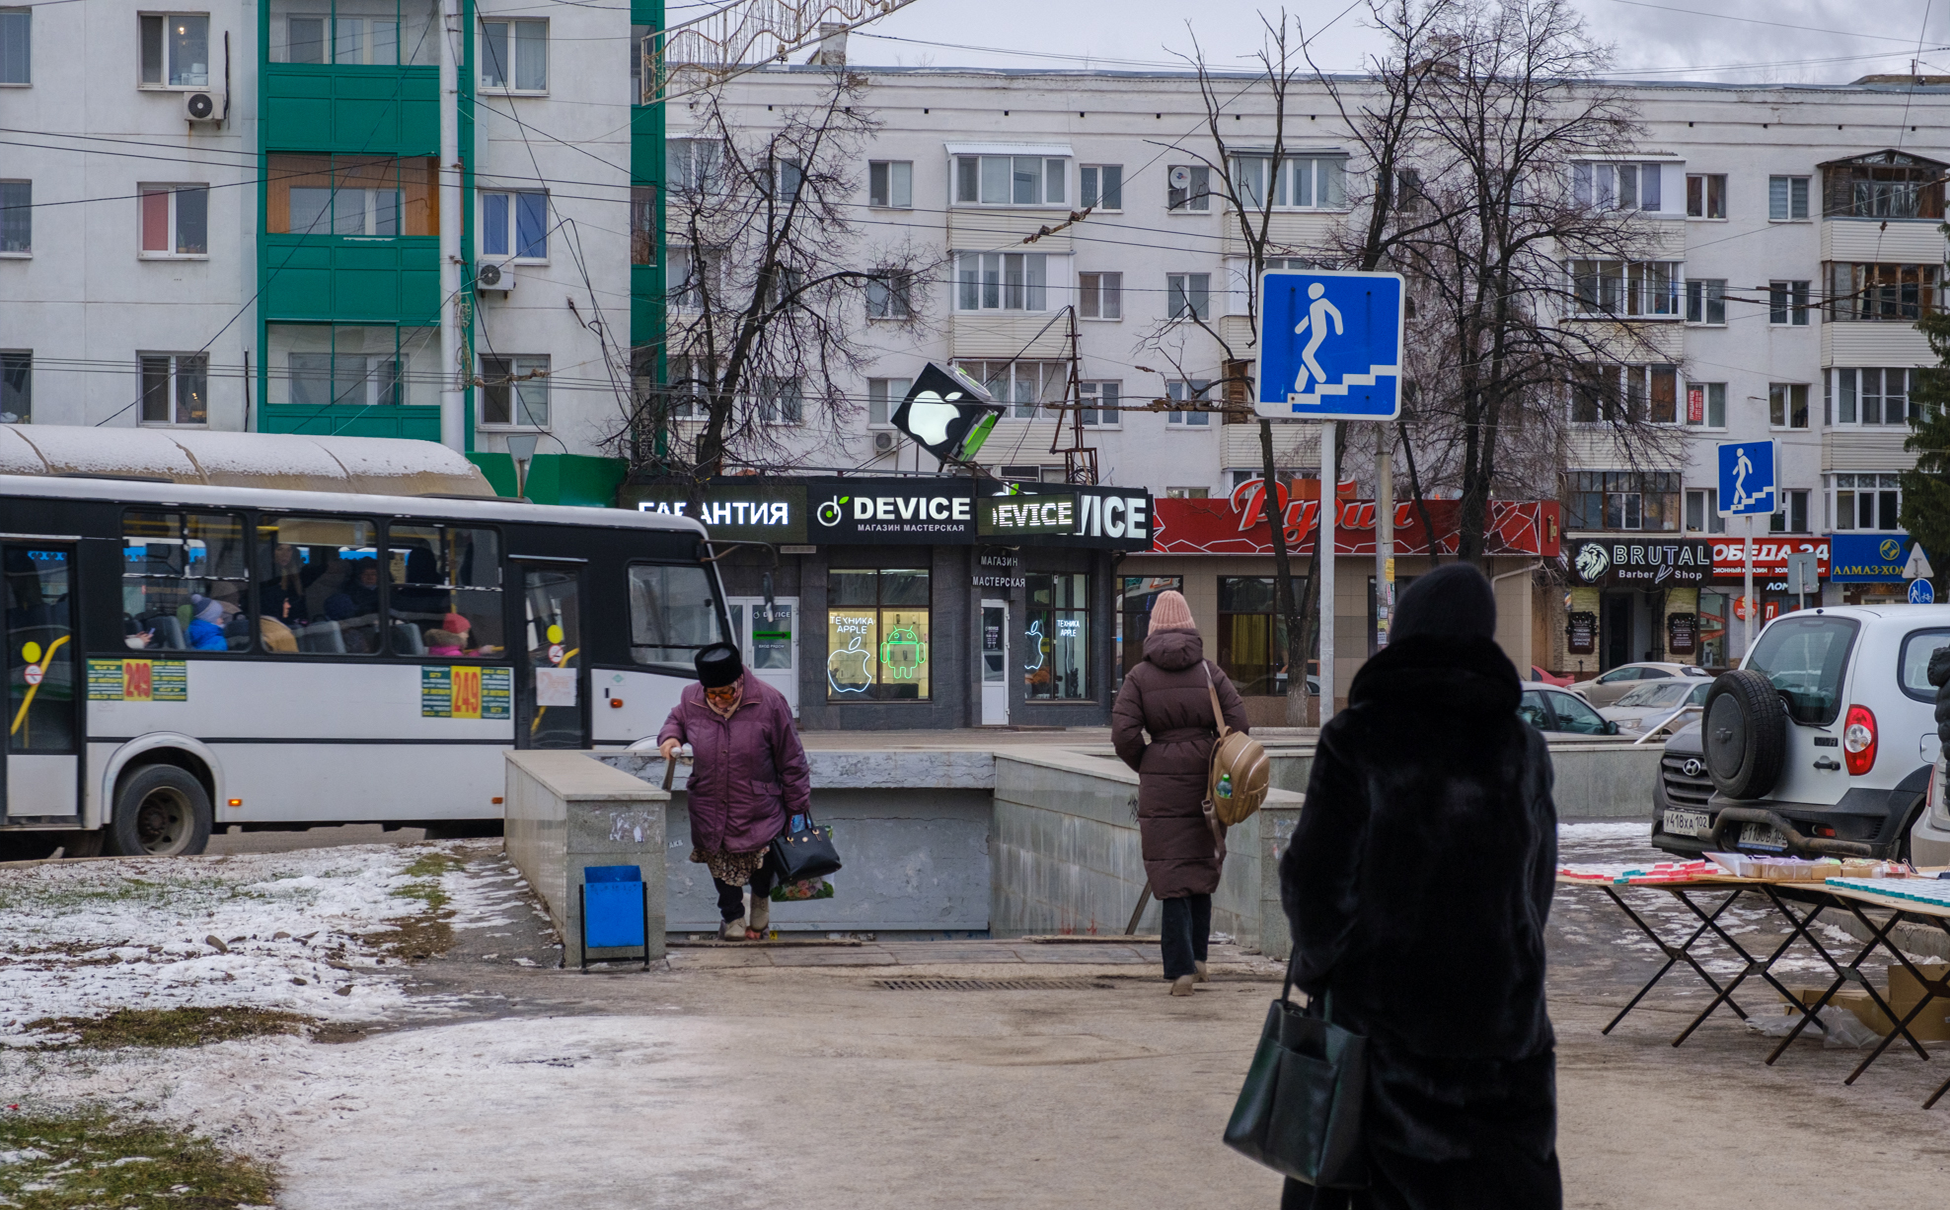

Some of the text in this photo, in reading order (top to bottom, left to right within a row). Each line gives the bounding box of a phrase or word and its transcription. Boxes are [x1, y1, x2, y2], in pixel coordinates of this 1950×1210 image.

[853, 497, 971, 520] DEVICE
[857, 524, 965, 532] МАГАЗИН МАСТЕРСКАЯ
[980, 555, 1018, 567] МАГАЗИН
[1613, 545, 1710, 566] BRUTAL
[1618, 569, 1703, 581] Barber Shop
[972, 576, 1026, 588] МАСТЕРСКАЯ
[830, 616, 874, 626] ТЕХНИКА
[837, 625, 867, 634] APPLE
[124, 662, 151, 698] 249
[454, 671, 479, 714] 249
